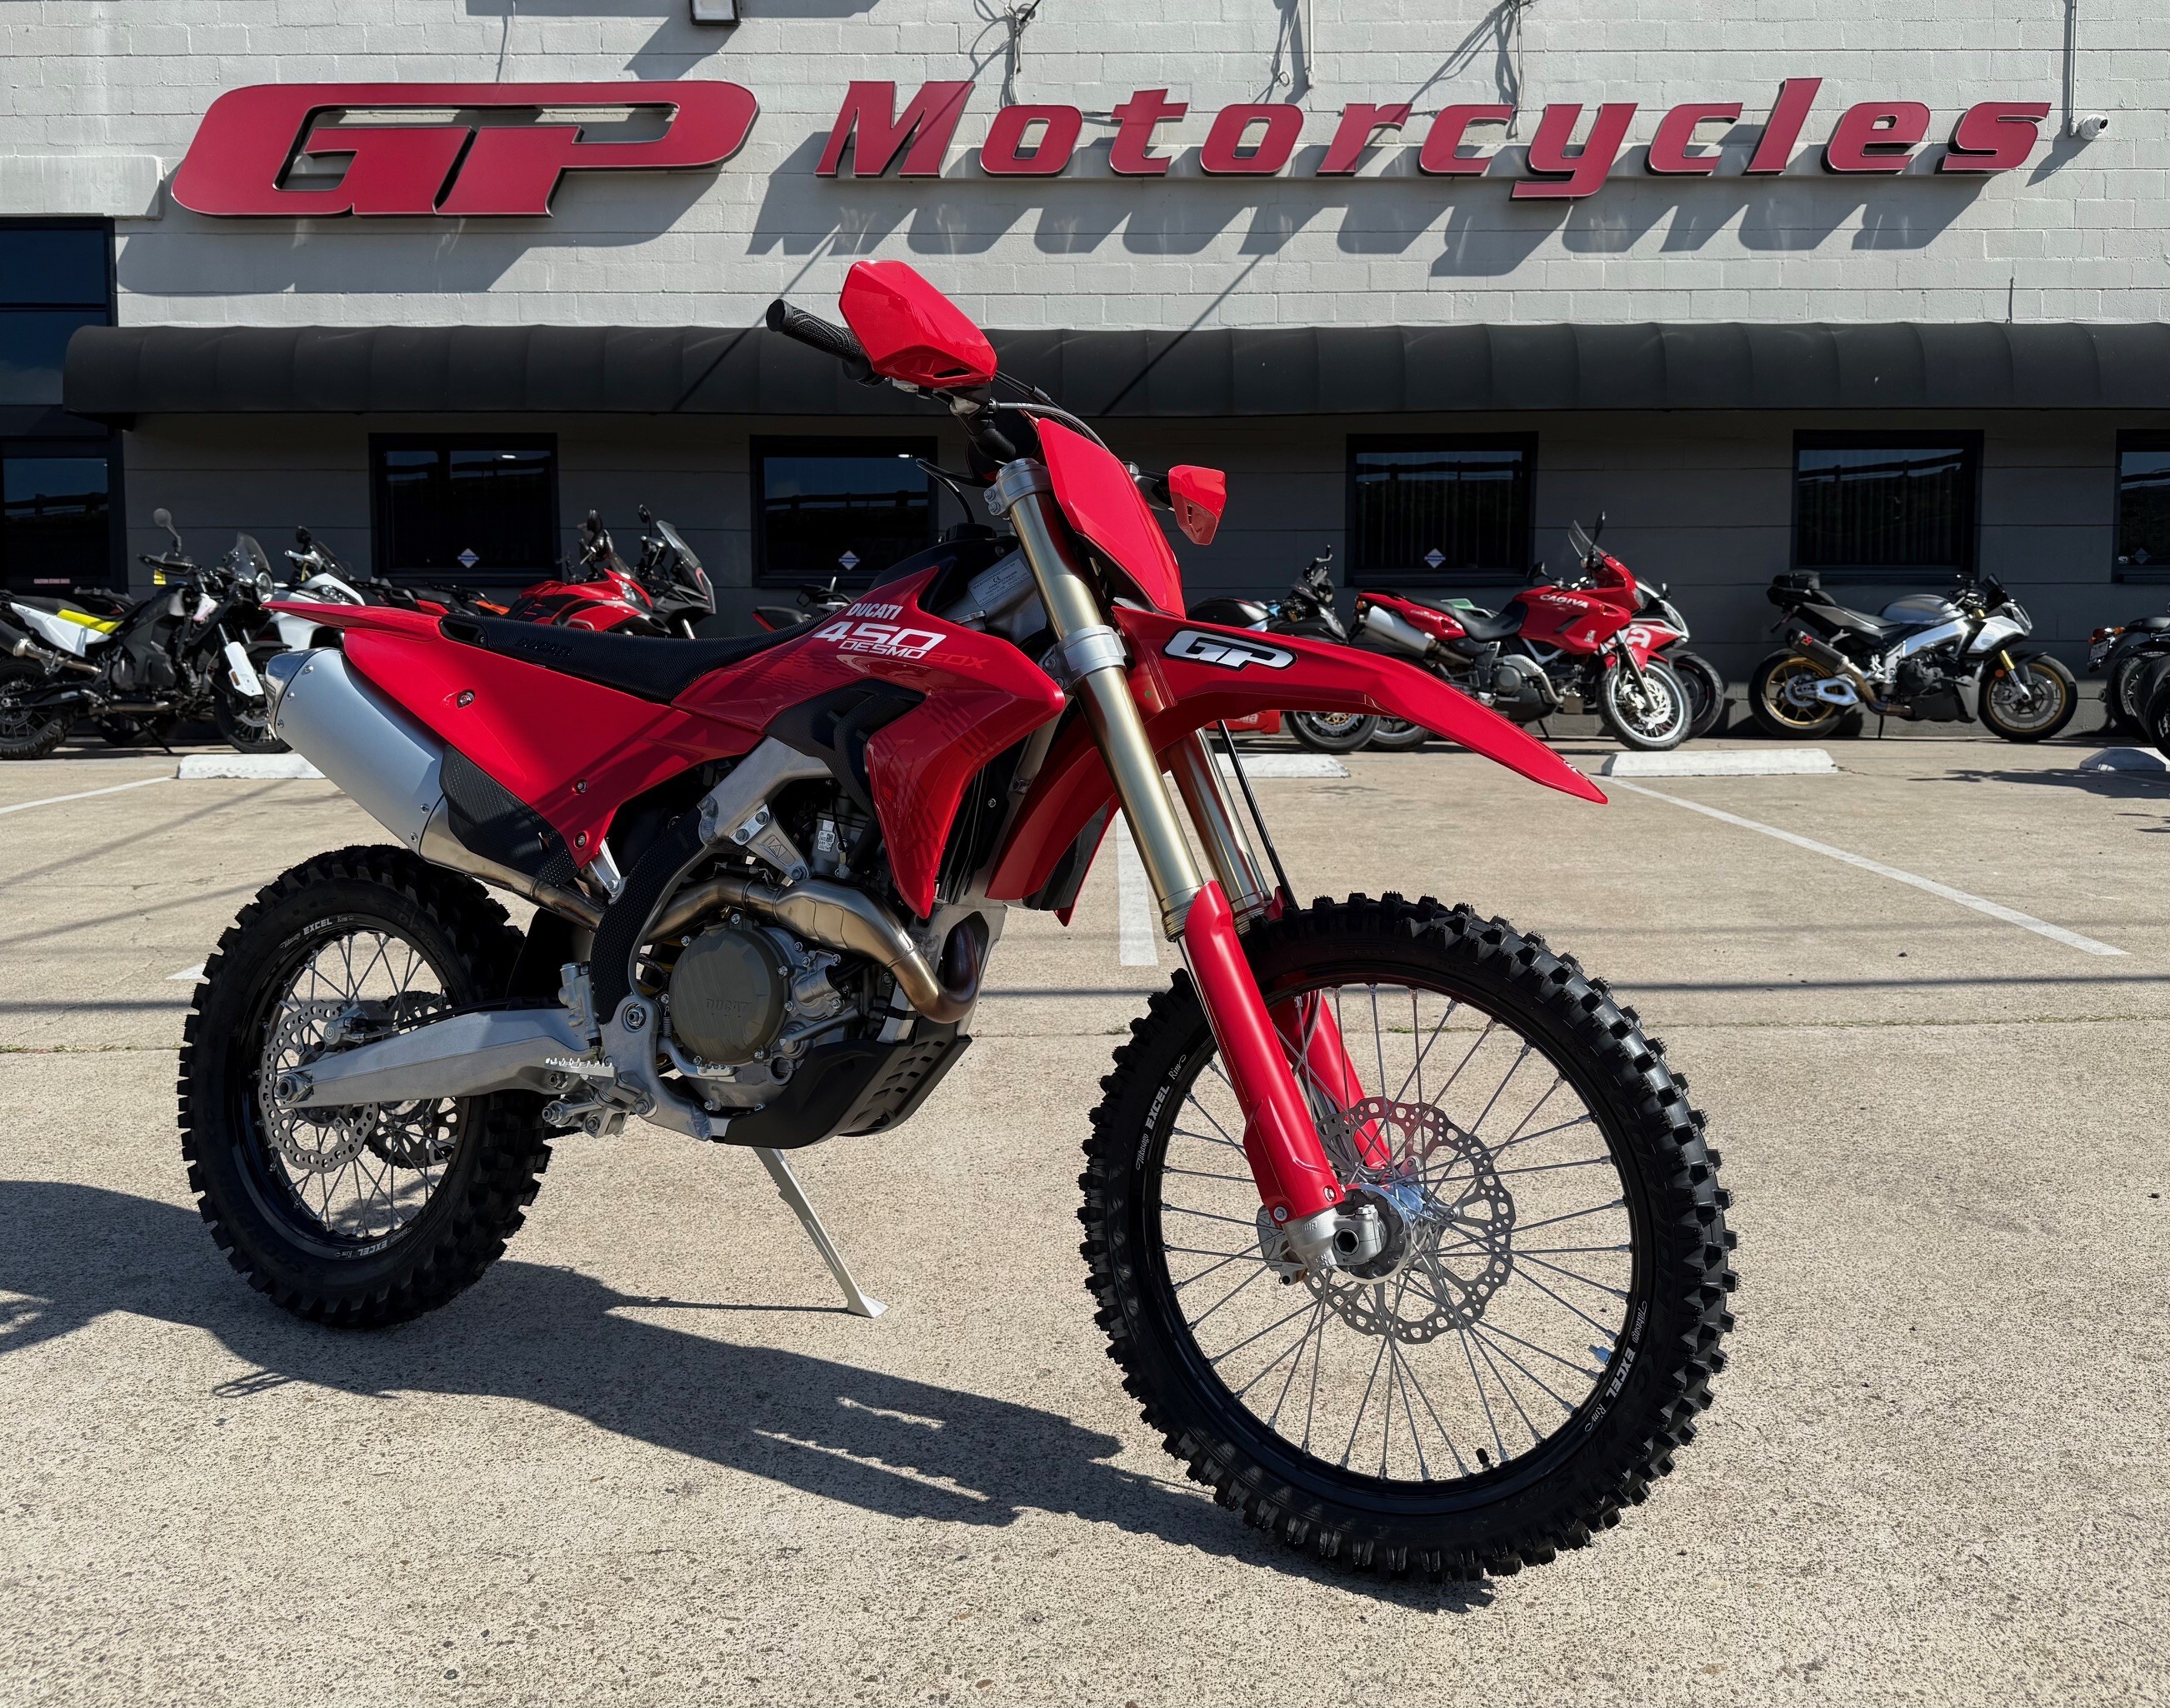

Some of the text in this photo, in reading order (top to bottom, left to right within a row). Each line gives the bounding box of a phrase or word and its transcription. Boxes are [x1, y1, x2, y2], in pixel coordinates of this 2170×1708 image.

[171, 77, 2051, 217] GP Motorcycles
[846, 602, 904, 621] DUCATI
[1539, 593, 1590, 609] CAGIVA
[812, 621, 948, 652] 450
[1164, 630, 1294, 668] GP
[838, 640, 928, 660] DESMO
[302, 918, 332, 936] EXCEL
[1145, 1085, 1170, 1131] EXCEL
[1168, 1054, 1187, 1080] Rim
[358, 1239, 388, 1256] EXCEL
[1584, 1301, 1648, 1432] Takasago EXCEL Rim
